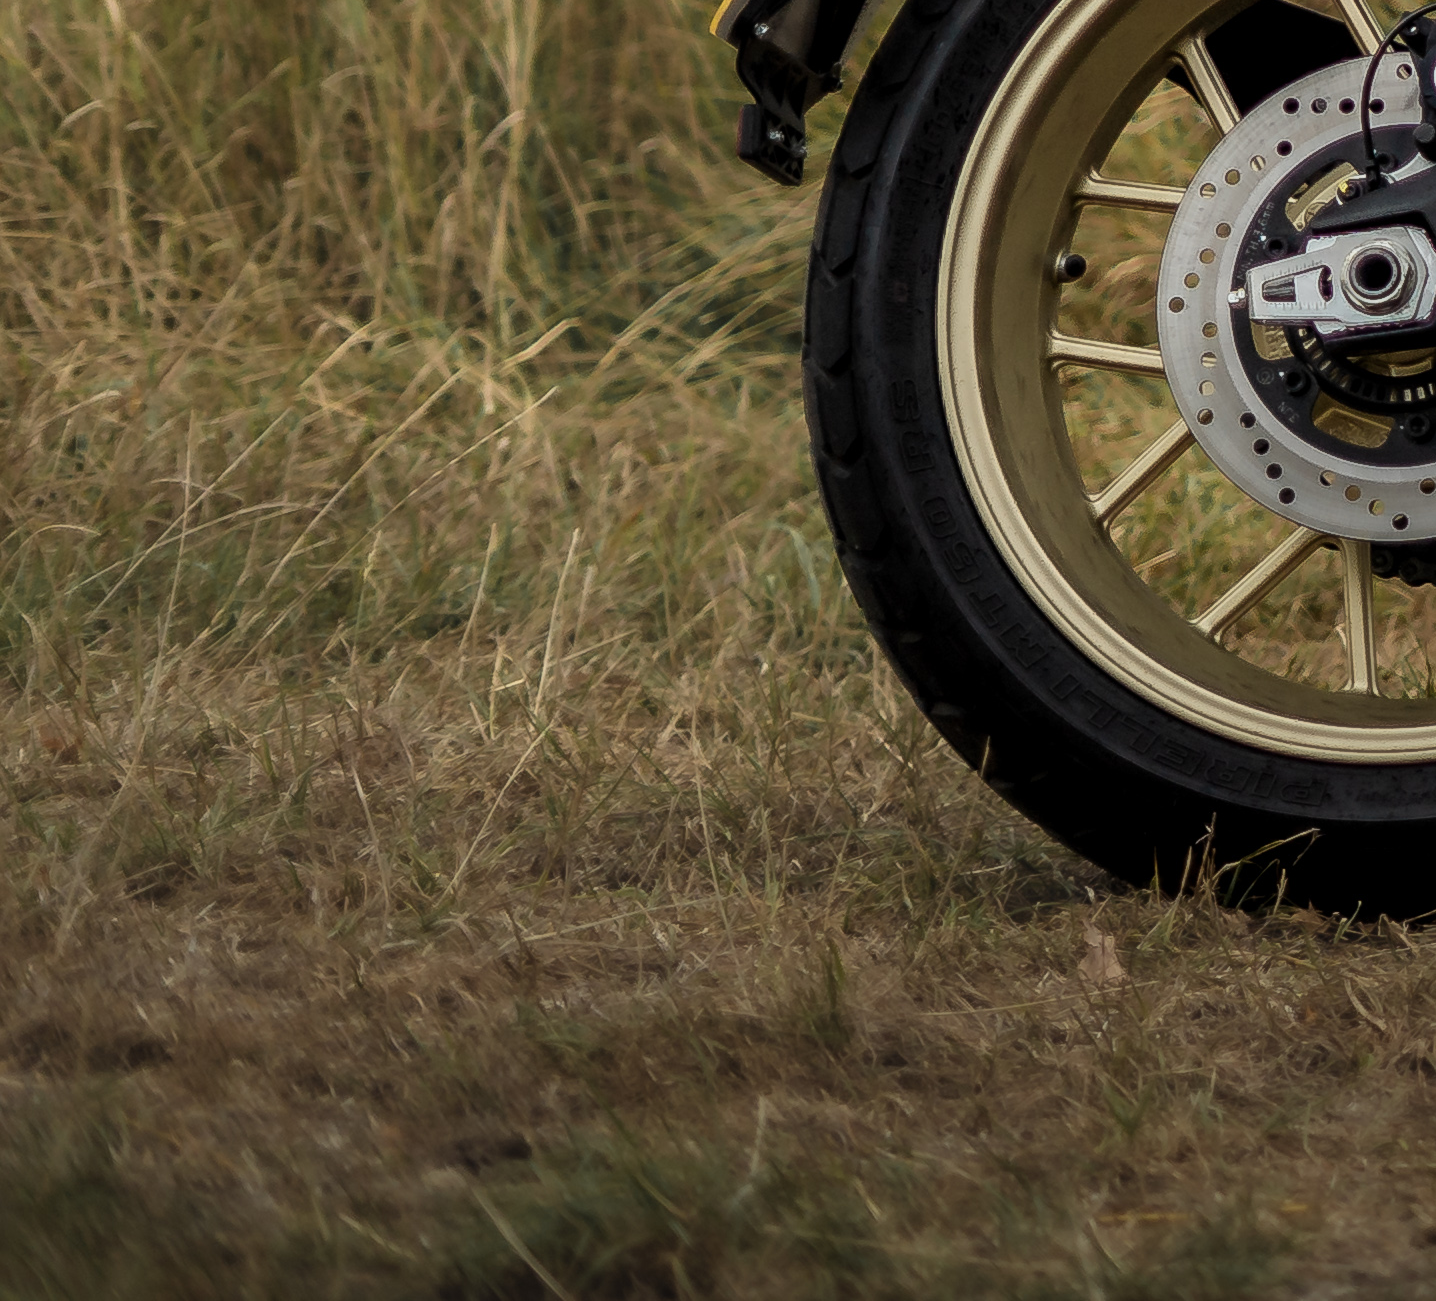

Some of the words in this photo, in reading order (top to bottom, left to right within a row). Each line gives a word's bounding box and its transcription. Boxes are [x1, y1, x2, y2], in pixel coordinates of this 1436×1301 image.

[885, 376, 938, 477] RS
[915, 491, 1050, 672] MT60
[1049, 669, 1327, 809] PIRELLI
